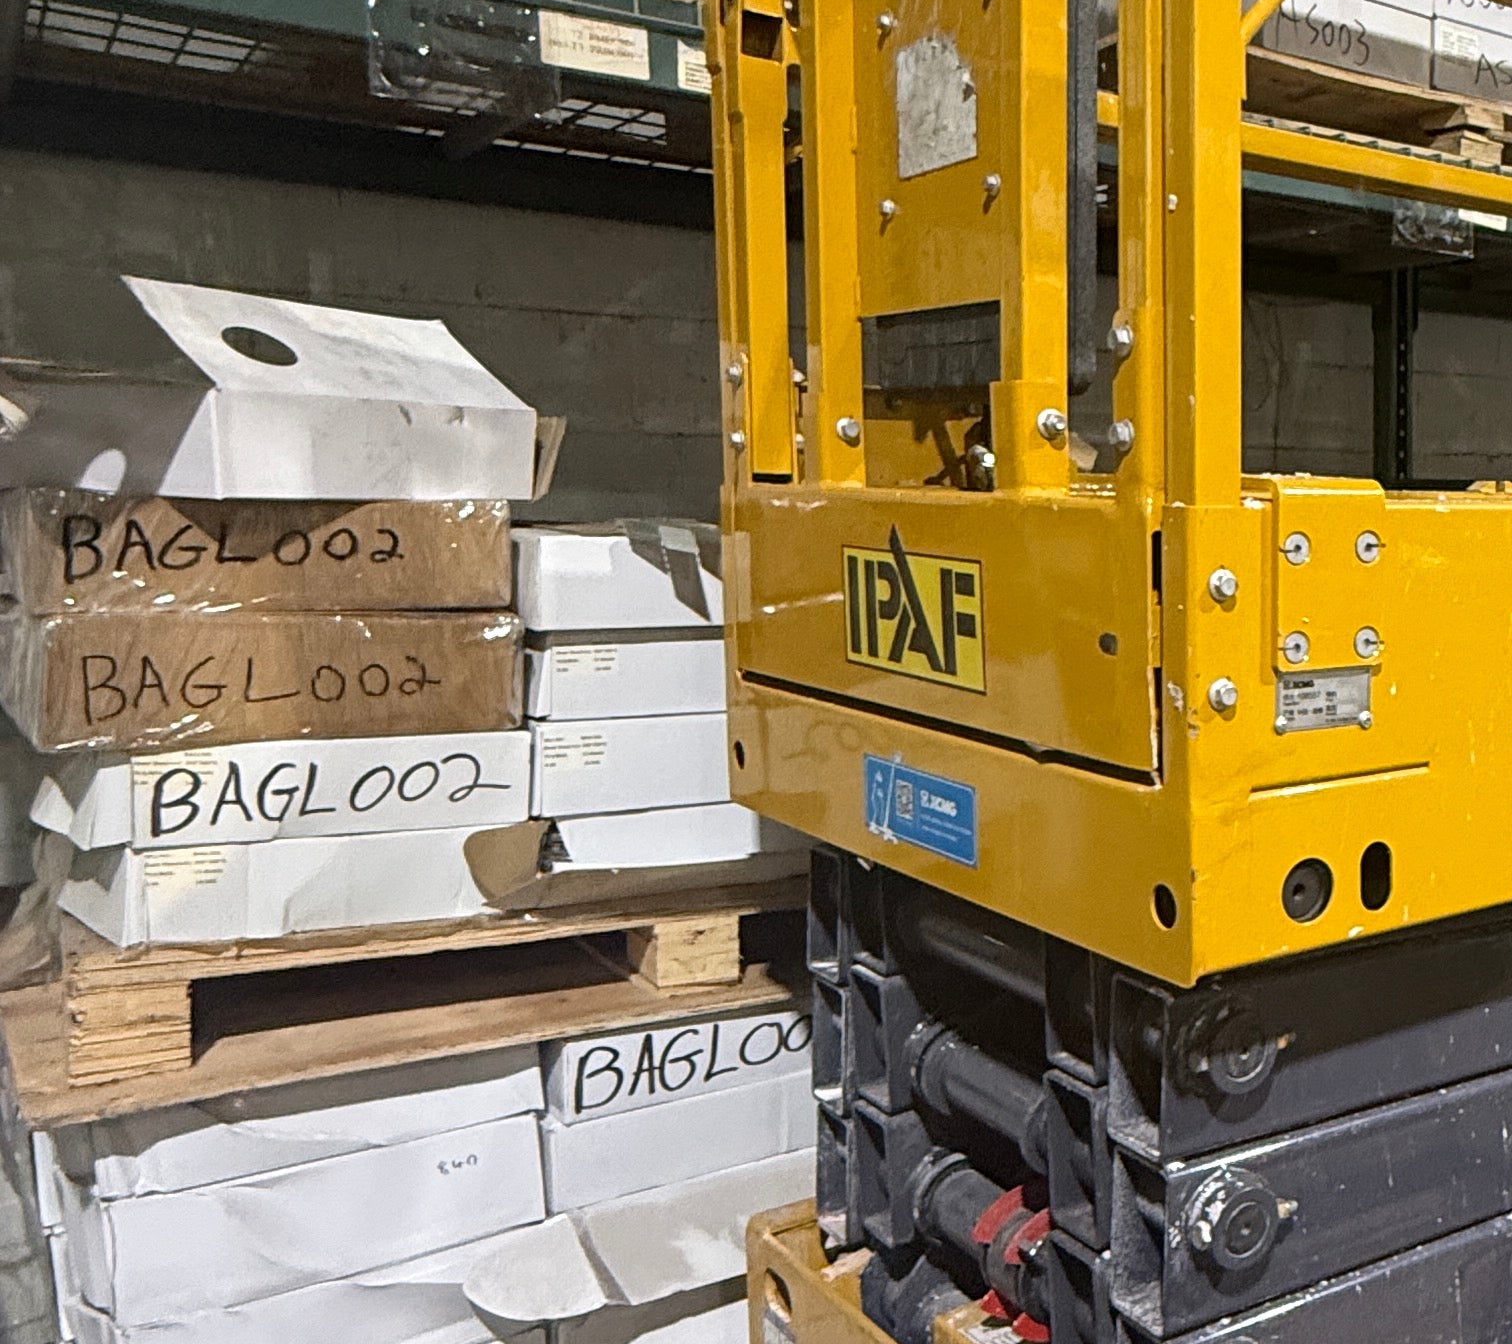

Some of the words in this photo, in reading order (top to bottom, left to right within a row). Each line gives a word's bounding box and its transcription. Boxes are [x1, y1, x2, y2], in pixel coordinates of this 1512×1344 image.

[62, 513, 405, 585] BAGL002
[847, 522, 977, 677] IPAF
[82, 654, 442, 726] BAGL002
[151, 752, 512, 838] BAGL002
